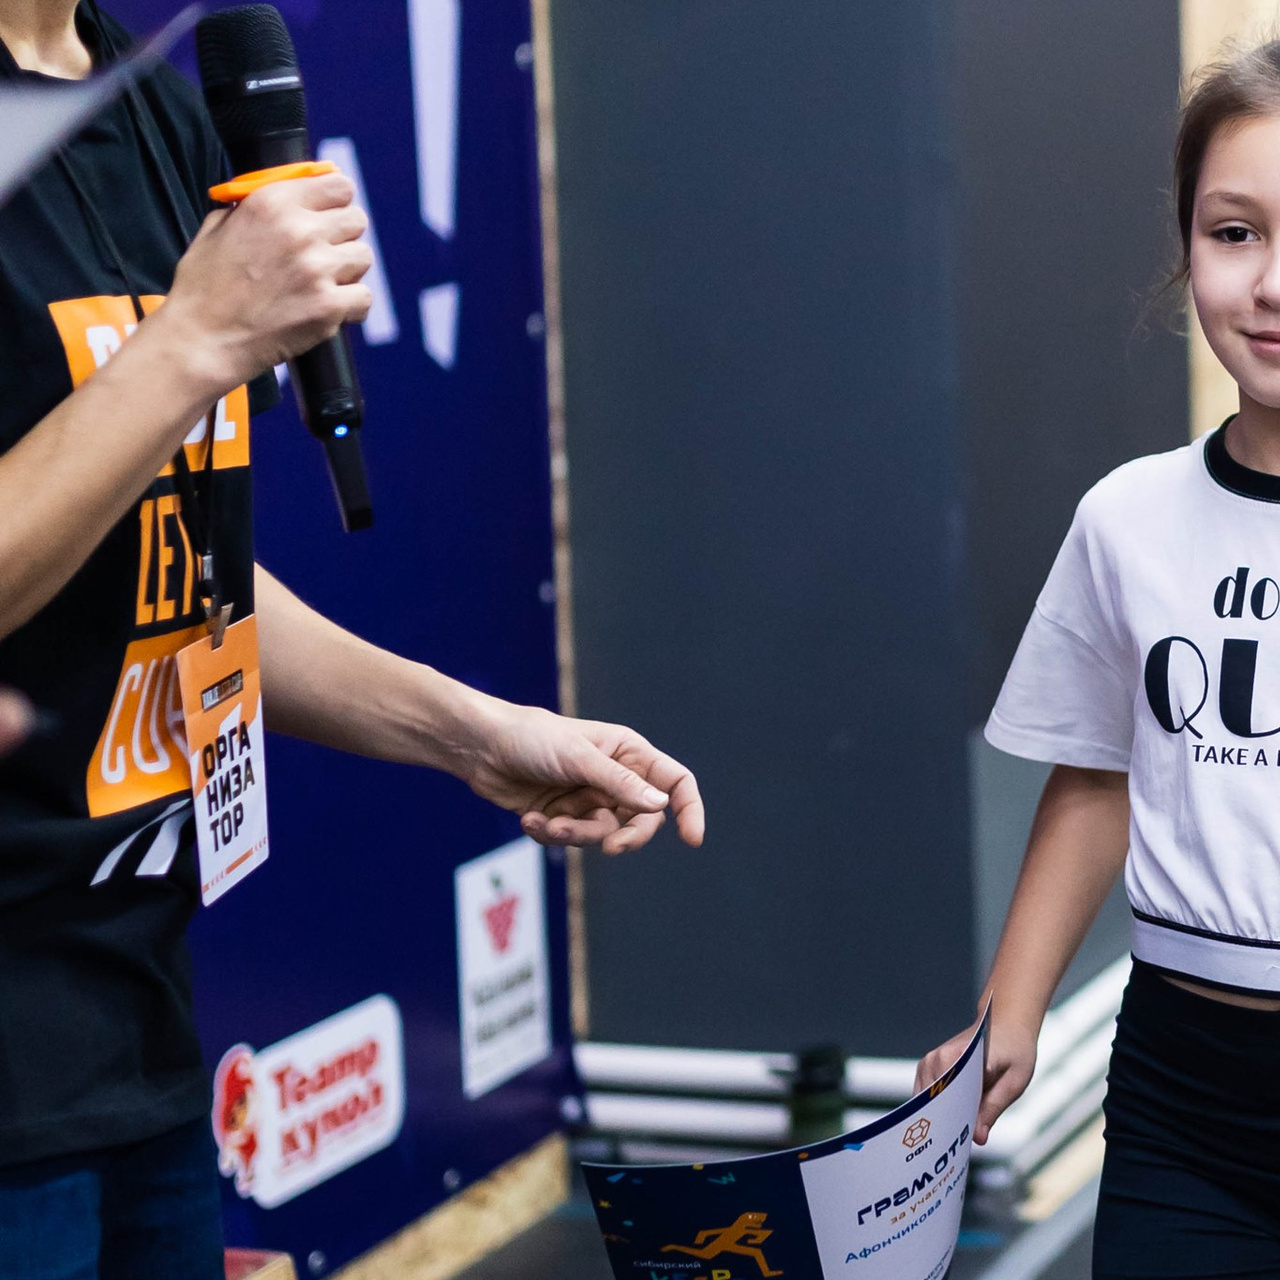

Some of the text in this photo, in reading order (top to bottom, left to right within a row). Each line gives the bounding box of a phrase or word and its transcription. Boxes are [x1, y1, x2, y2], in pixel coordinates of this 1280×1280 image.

[201, 721, 251, 779] ОРГА
[1191, 744, 1250, 766] TAKE
[1253, 748, 1269, 767] A
[206, 756, 256, 817] НИЗА
[209, 802, 245, 853] ТОР
[905, 1138, 933, 1163] ОФП
[845, 1198, 942, 1264] Афончикова
[890, 1211, 907, 1225] за
